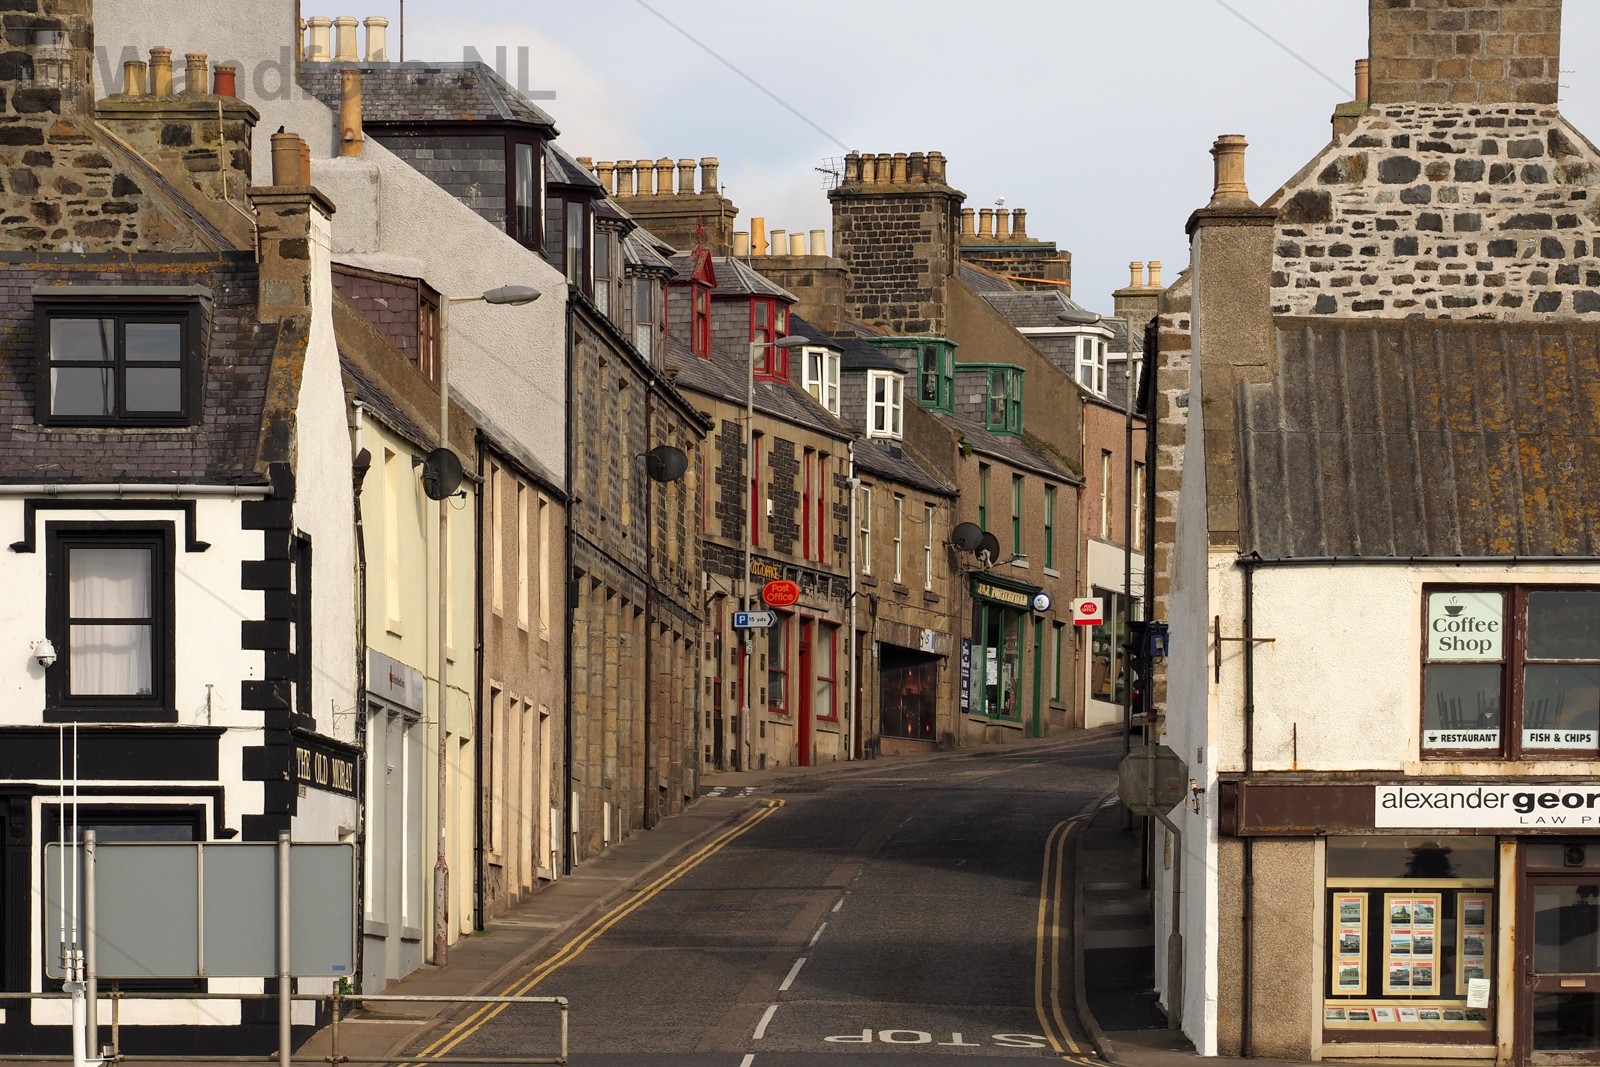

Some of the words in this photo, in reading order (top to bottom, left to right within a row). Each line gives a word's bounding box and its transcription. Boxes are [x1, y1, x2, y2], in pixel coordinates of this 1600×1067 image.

[767, 593, 793, 601] Office
[739, 615, 745, 624] P
[1432, 617, 1499, 633] Coffee
[1439, 636, 1492, 654] Shop
[1441, 733, 1497, 743] RESTAURANT
[1530, 733, 1551, 743] FISH
[1554, 733, 1561, 742] &
[1564, 733, 1592, 743] CHIPS
[296, 747, 310, 780] THE
[314, 752, 328, 785] OLD
[332, 758, 353, 792] MORAY
[1520, 816, 1567, 824] LAW
[823, 1028, 1048, 1048] STOP
